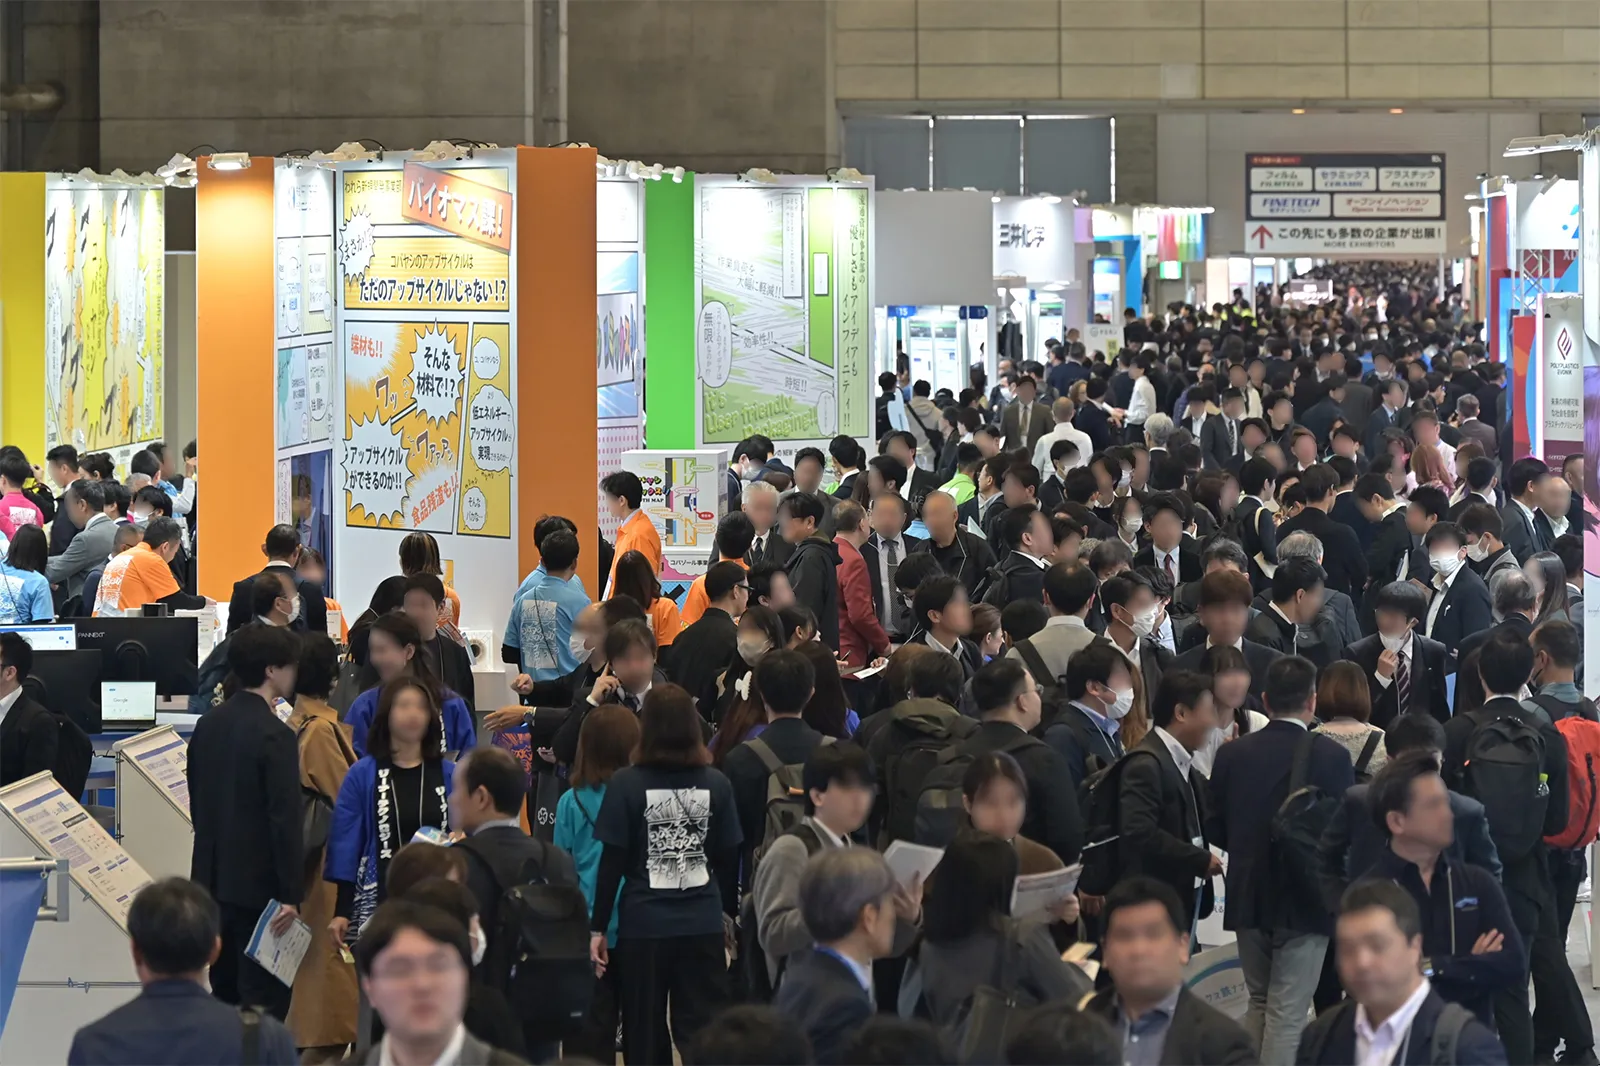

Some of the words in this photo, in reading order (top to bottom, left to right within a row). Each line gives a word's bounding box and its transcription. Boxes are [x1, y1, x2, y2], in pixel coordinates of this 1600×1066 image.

[408, 177, 504, 239] バイオマス課!
[1262, 198, 1320, 207] FINETECH
[1278, 227, 1441, 239] この先にも多数の企業が出展!
[390, 254, 474, 270] コバヤシのアップサイクルは
[359, 277, 507, 303] ただのアップサイクルじゃない!?
[423, 346, 451, 371] そんな
[350, 446, 403, 466] アップサイクル
[349, 471, 402, 490] ができるのか!!
